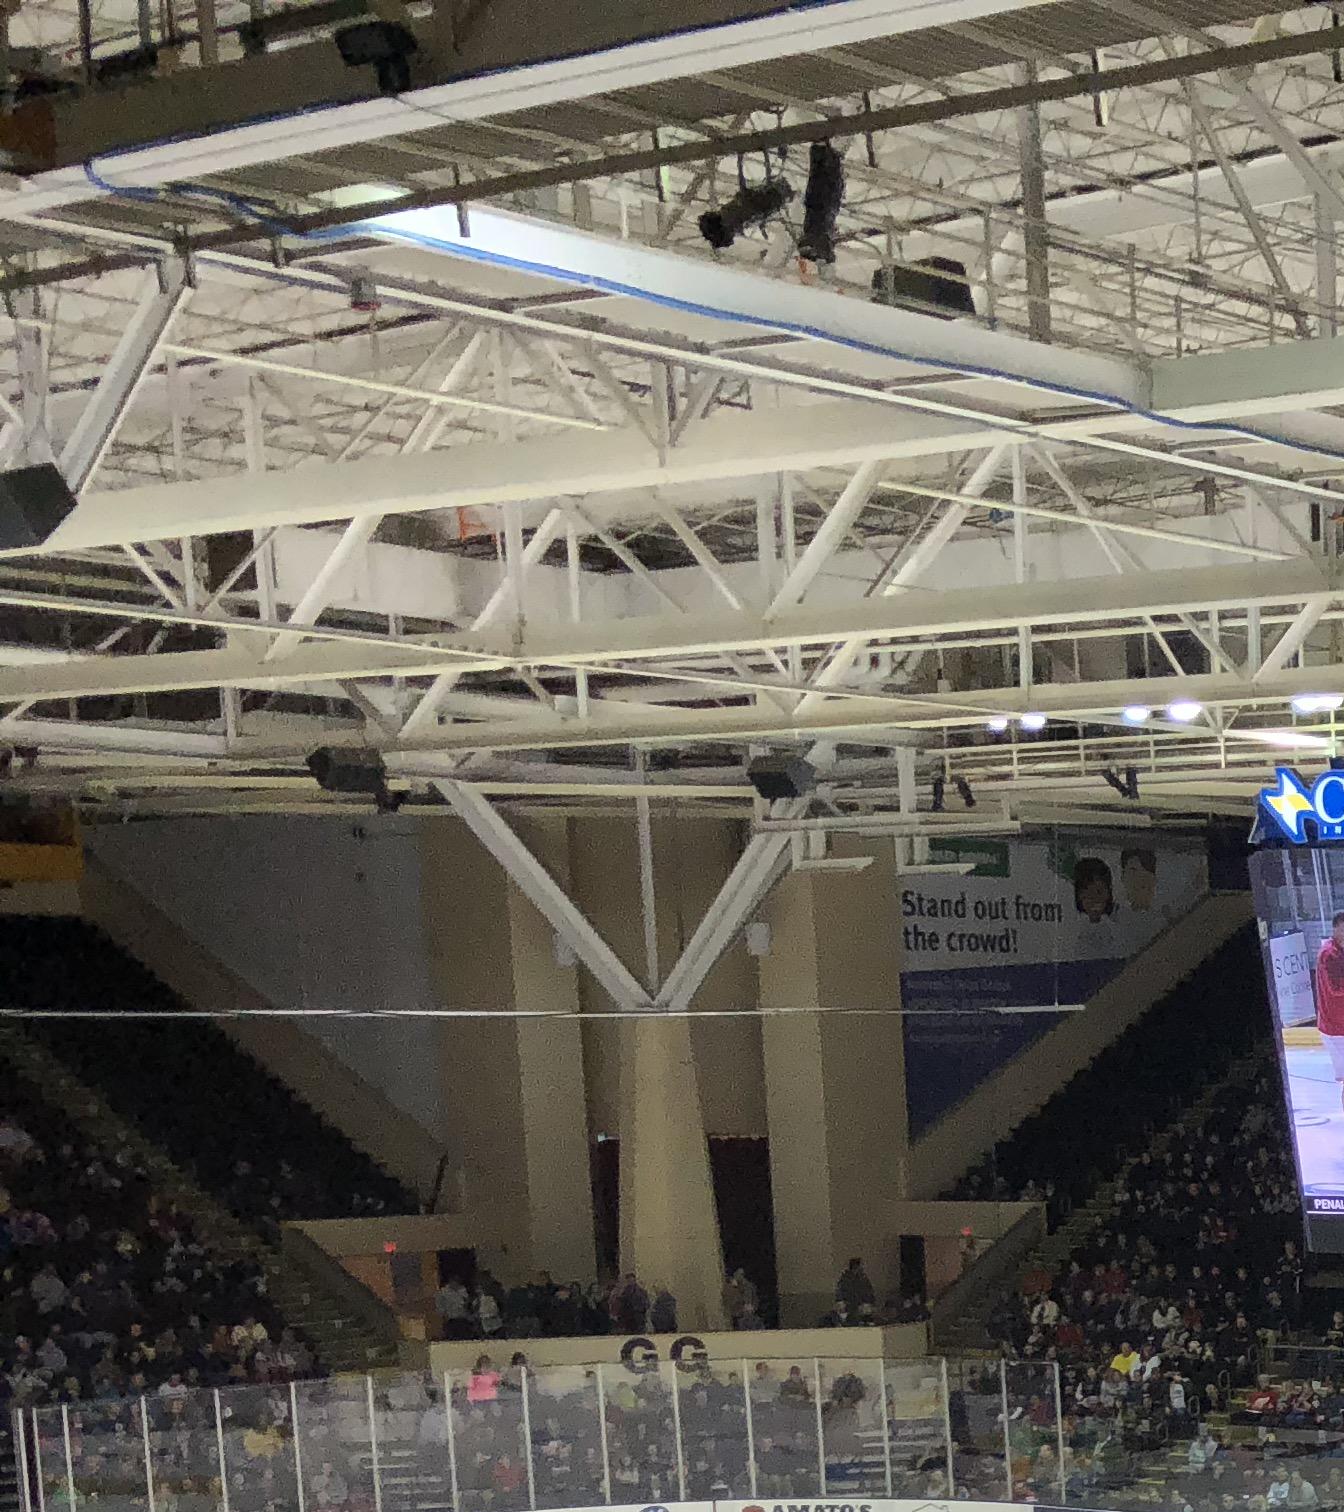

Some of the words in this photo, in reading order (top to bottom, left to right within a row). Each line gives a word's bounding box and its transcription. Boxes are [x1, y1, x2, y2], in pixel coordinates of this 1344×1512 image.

[901, 890, 967, 920] Stand
[974, 898, 1009, 921] out
[1015, 895, 1063, 923] from
[904, 924, 940, 951] the
[946, 928, 1019, 953] crowd!
